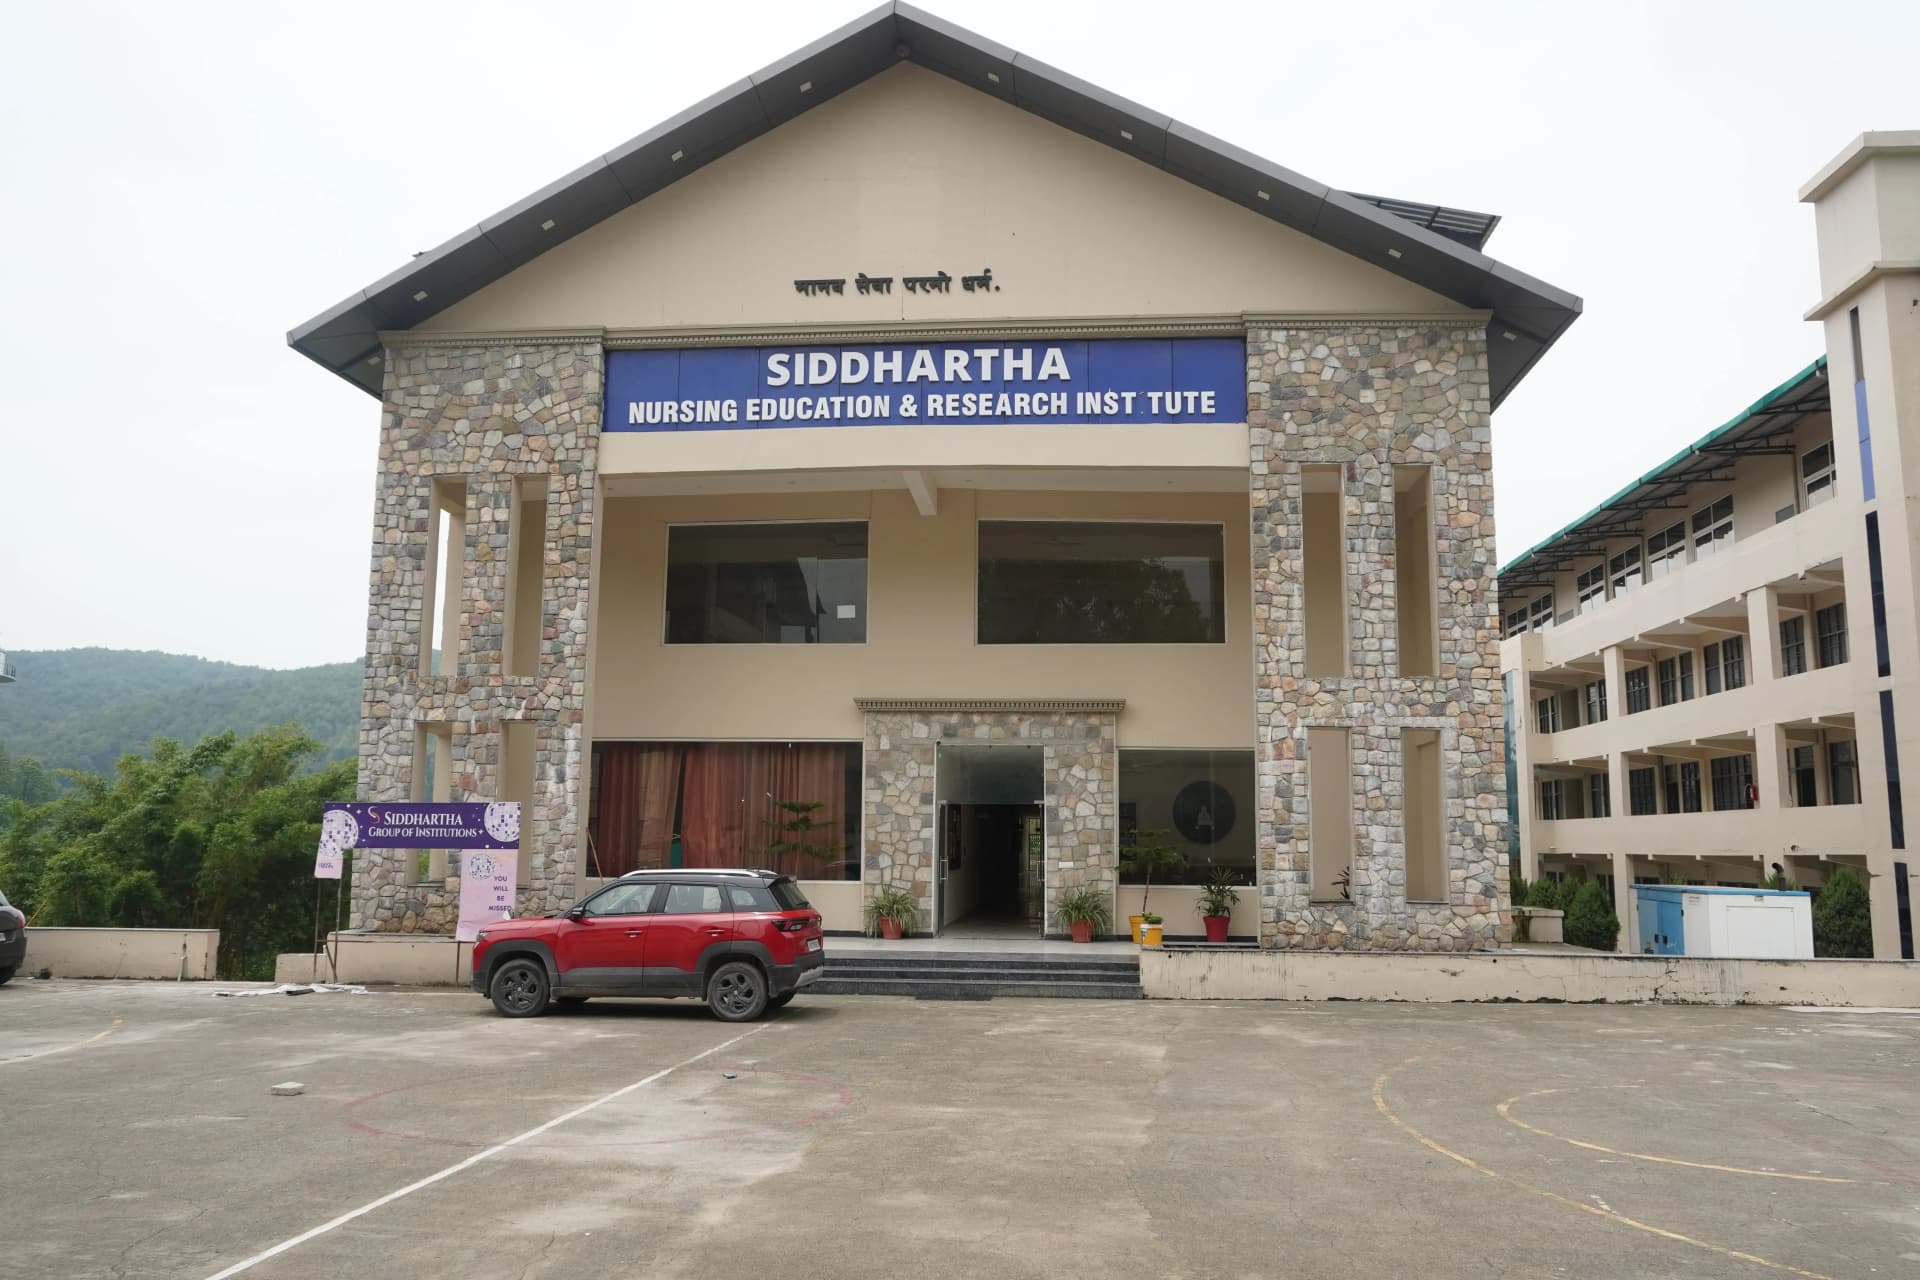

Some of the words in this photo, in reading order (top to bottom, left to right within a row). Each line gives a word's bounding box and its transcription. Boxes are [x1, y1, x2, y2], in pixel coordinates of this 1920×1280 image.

[794, 278, 846, 297] मानव
[855, 272, 893, 295] सेवा
[902, 270, 952, 294] परमो
[766, 347, 1072, 387] SIDDHARTHA
[628, 399, 738, 424] NURSING
[746, 394, 890, 421] EDUCATION
[899, 393, 918, 418] &
[927, 392, 1068, 417] RESEARCH
[368, 826, 401, 838] GROUP
[401, 827, 414, 837] OF
[415, 826, 478, 838] INSTITUTIONS
[384, 811, 463, 826] SIDDHARTHA
